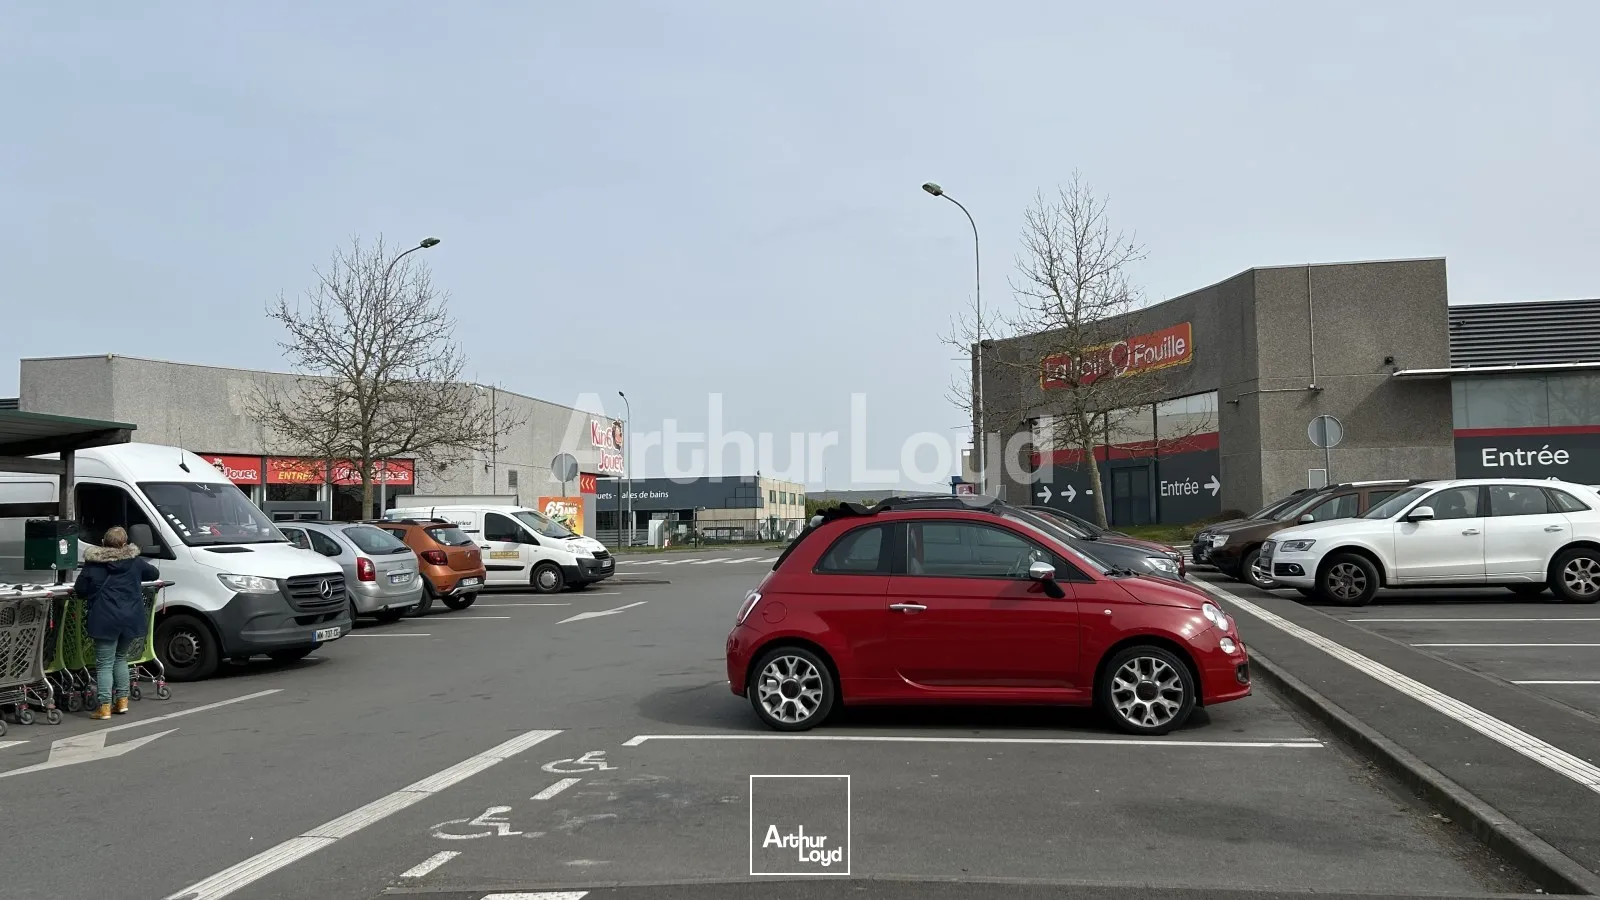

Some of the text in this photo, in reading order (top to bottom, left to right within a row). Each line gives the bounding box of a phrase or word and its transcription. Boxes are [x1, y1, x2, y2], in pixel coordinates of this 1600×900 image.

[1134, 335, 1186, 367] Fouille
[598, 448, 624, 473] Jouet
[1481, 444, 1570, 467] Entrée
[224, 467, 258, 480] Jouet
[639, 490, 649, 499] de
[649, 490, 669, 498] bains
[1160, 477, 1199, 496] Entrée
[545, 501, 564, 517] 65
